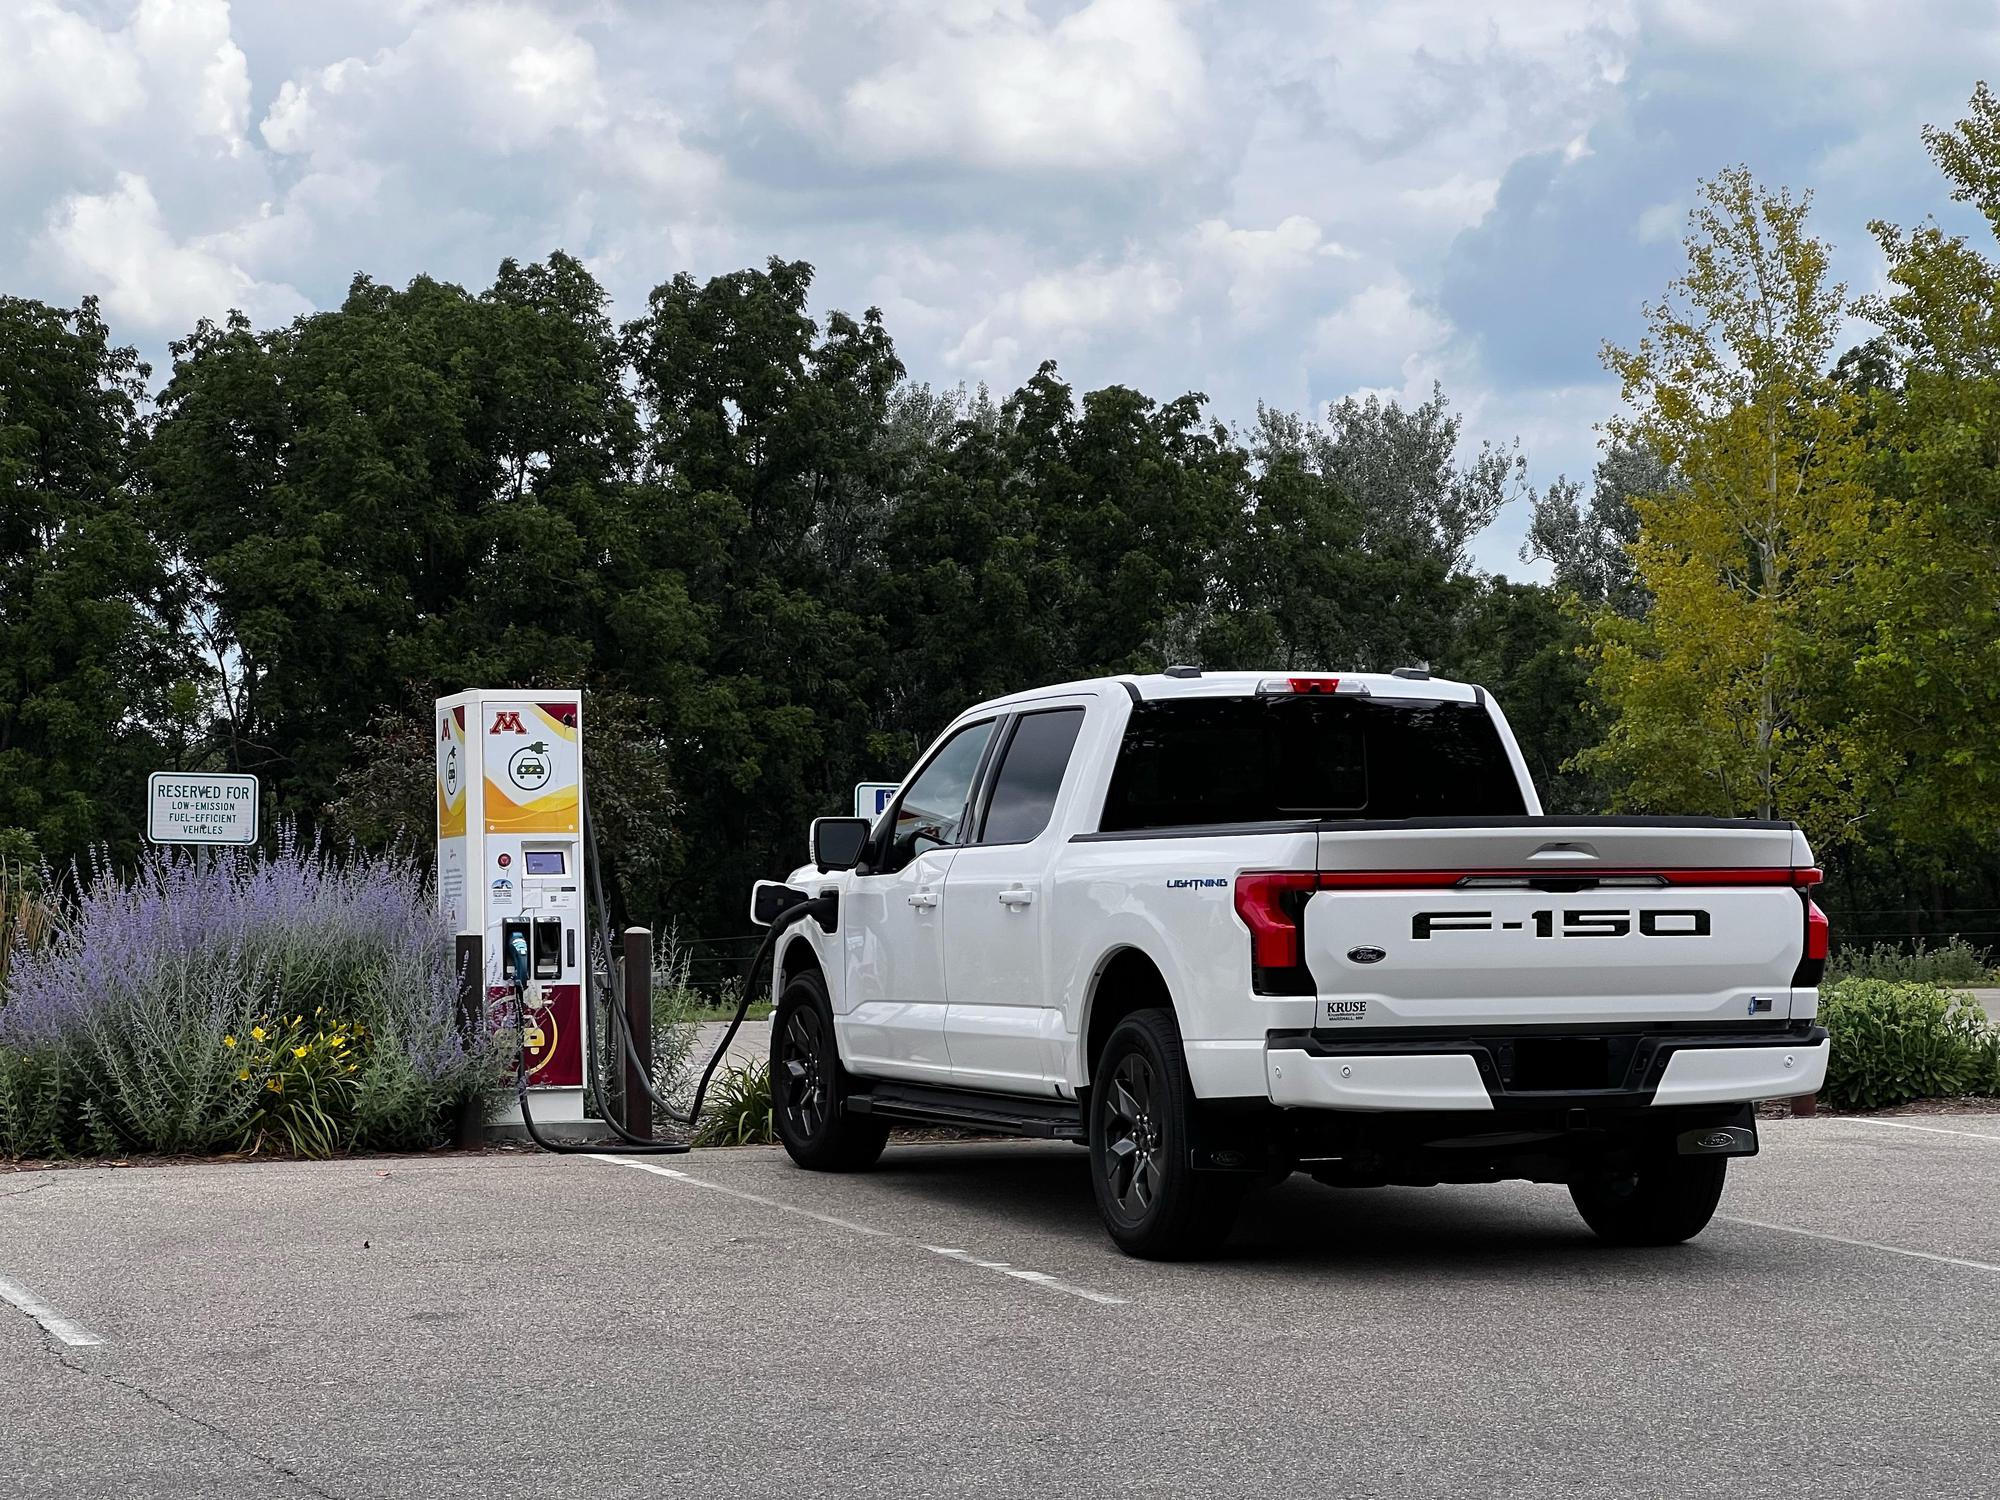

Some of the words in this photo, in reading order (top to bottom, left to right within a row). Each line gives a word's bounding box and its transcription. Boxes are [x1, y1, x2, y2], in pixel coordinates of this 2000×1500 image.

[490, 711, 527, 735] M
[158, 785, 221, 799] RESERVED
[227, 786, 249, 800] FOR
[172, 801, 235, 811] LOW-EMISSION
[169, 813, 237, 823] FUEL-EFFICIENT
[183, 825, 223, 835] VEHICLES
[1166, 878, 1228, 890] LIGHTNING
[1411, 909, 1711, 940] F-150
[1327, 1001, 1367, 1013] KRUSE
